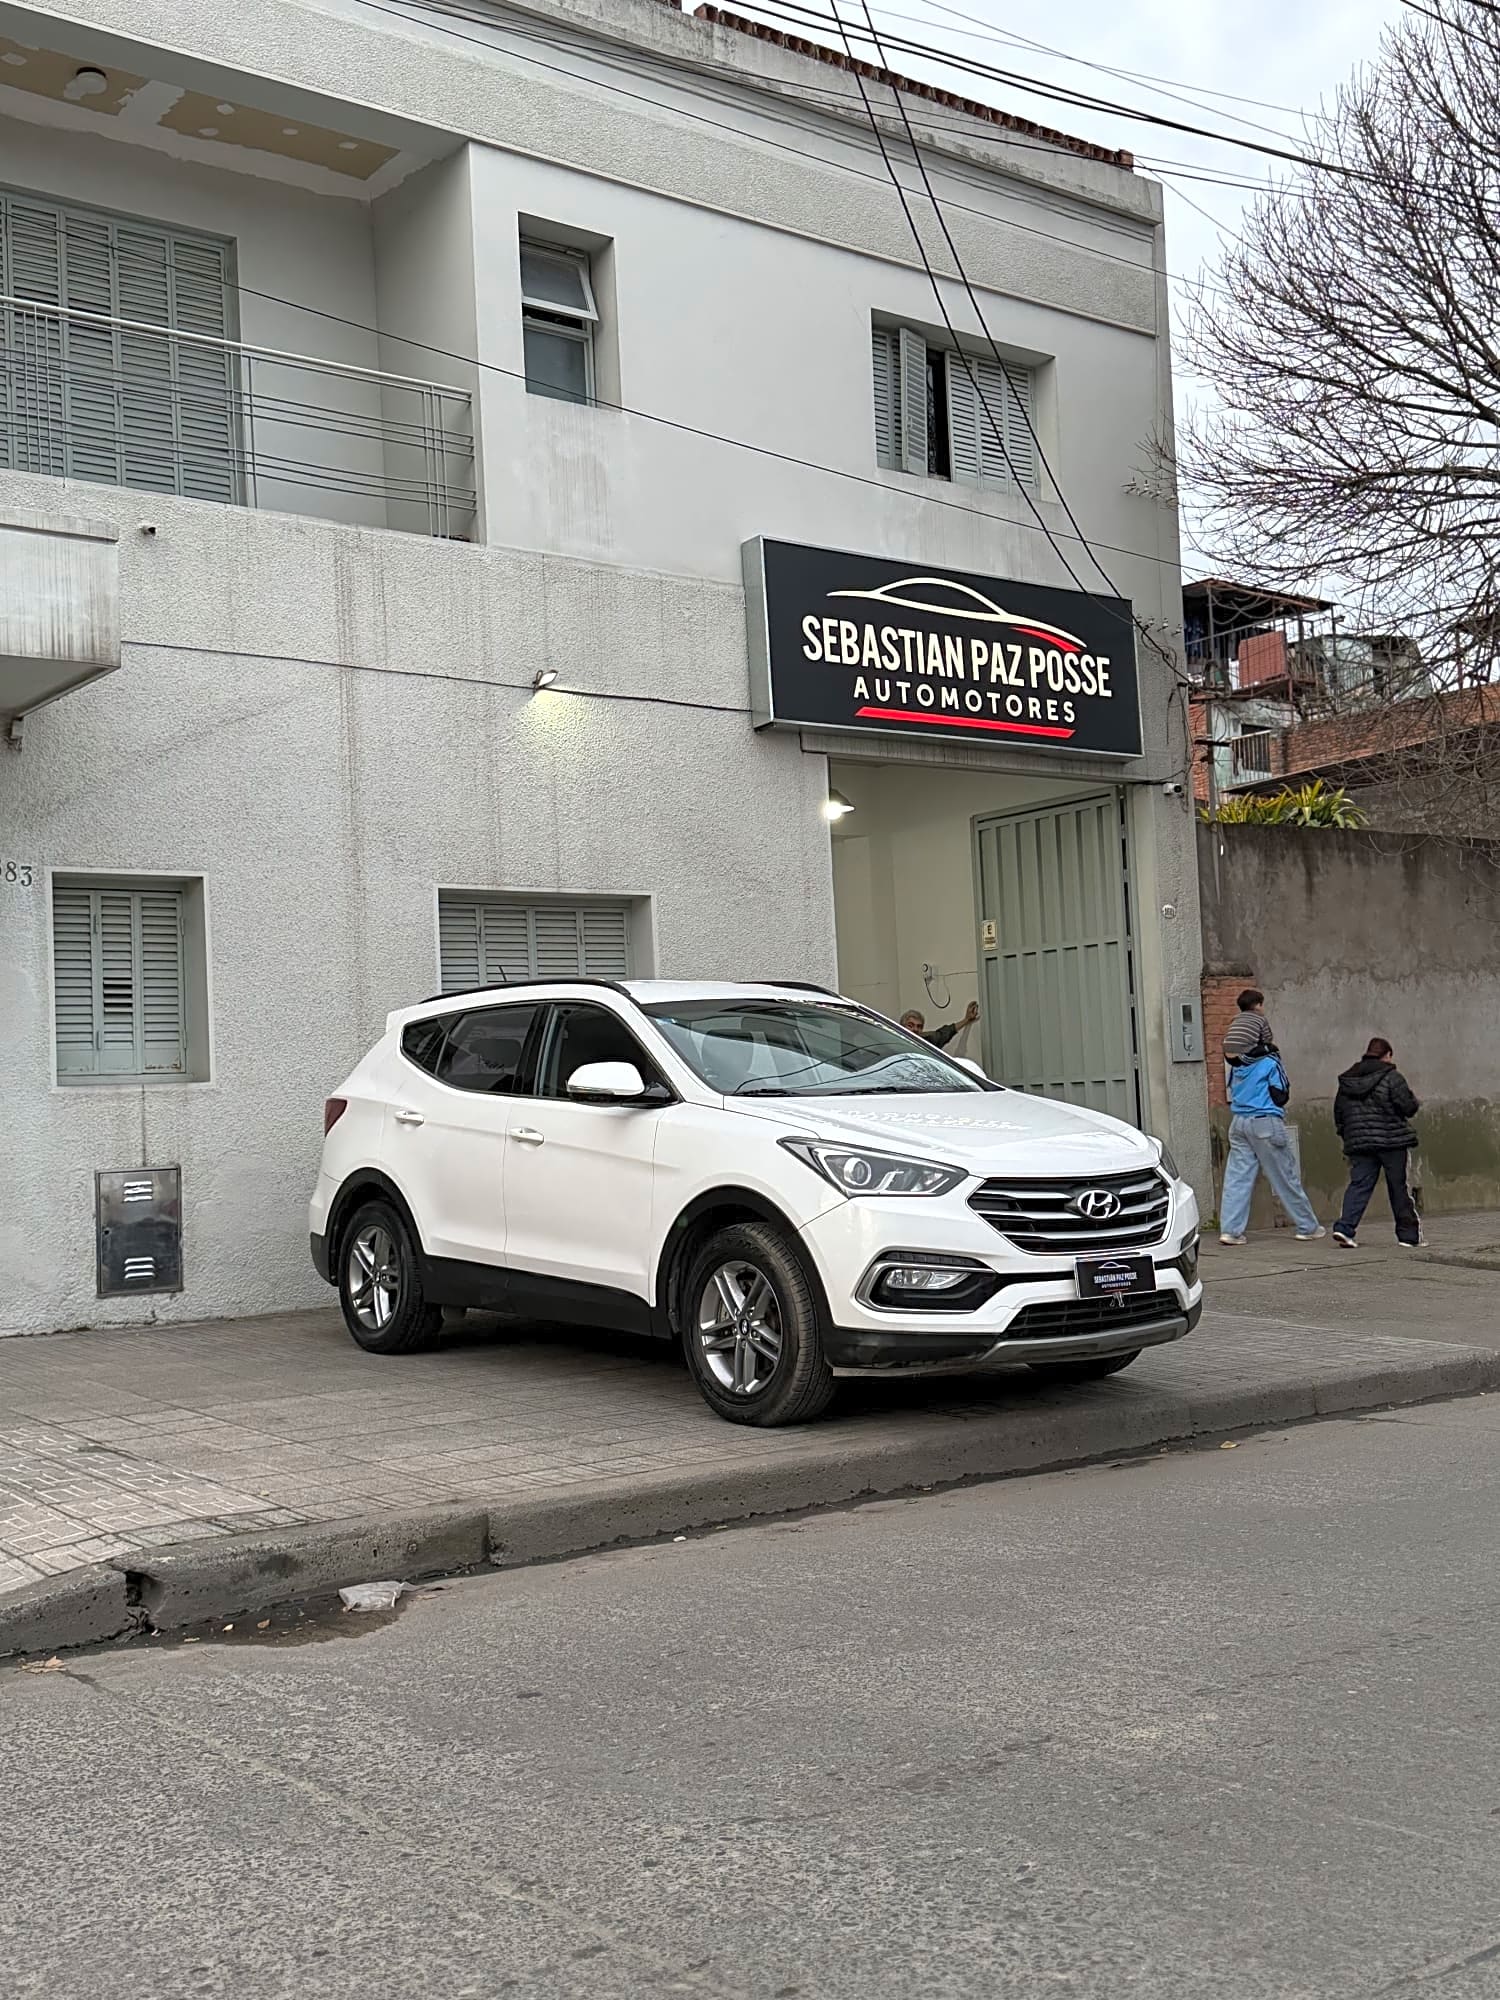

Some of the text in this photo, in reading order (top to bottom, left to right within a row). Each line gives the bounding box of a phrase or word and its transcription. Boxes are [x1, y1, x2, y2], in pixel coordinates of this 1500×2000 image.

[801, 615, 1113, 698] SEBASTIAN PAZ POSSE
[853, 676, 1076, 723] AUTOMOTORES
[0, 859, 33, 887] 83
